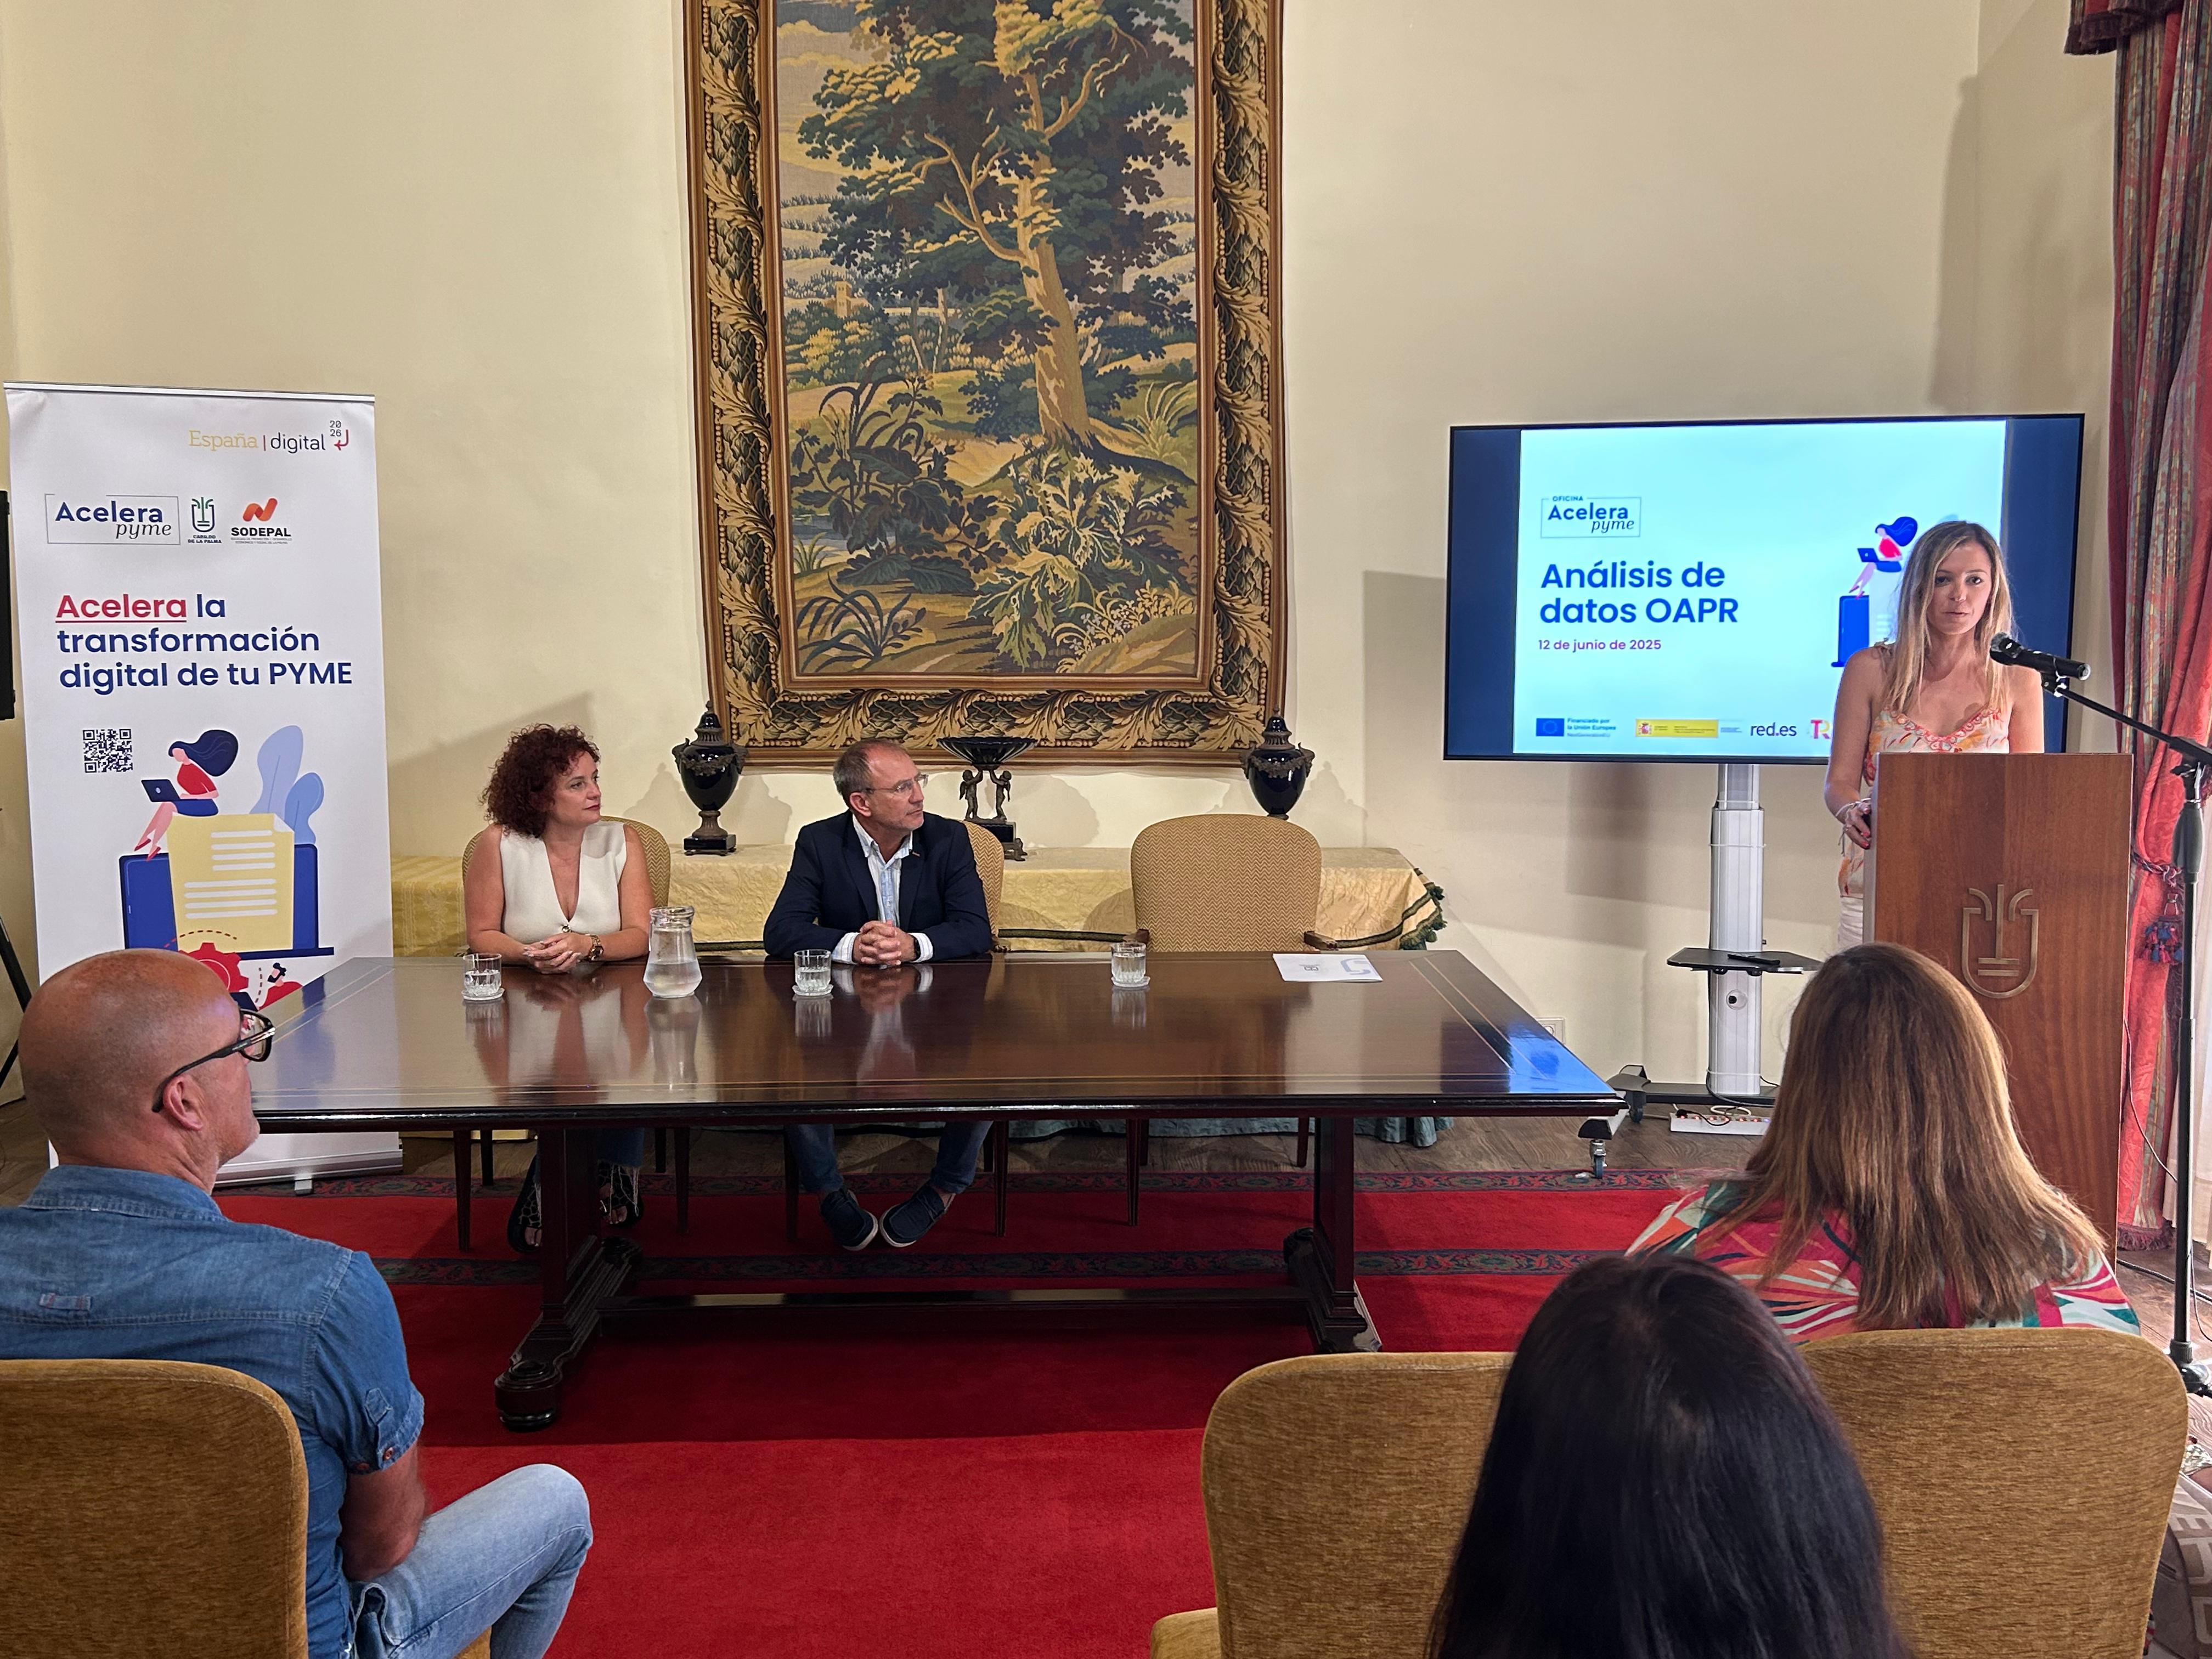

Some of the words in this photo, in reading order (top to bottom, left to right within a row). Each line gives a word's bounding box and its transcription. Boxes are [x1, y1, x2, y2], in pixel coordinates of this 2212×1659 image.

[189, 430, 258, 452] España
[270, 432, 326, 454] digital
[55, 500, 163, 522] Acelera
[1547, 502, 1629, 521] Acelera
[116, 523, 172, 540] pyme
[230, 527, 291, 537] SODEPAL
[1591, 520, 1635, 533] pyme
[1541, 560, 1673, 589] Análisis
[1681, 561, 1725, 588] de
[56, 594, 187, 618] Acelera
[196, 594, 226, 618] la
[1539, 597, 1637, 623] datos
[1645, 597, 1739, 623] OAPR
[57, 626, 320, 653] transformación
[1538, 640, 1550, 650] 12
[1553, 640, 1570, 650] de
[1572, 639, 1606, 653] junio
[1609, 640, 1626, 650] de
[1629, 640, 1662, 650] 2025
[59, 662, 168, 695] digital
[177, 662, 219, 686] de
[227, 663, 259, 685] tu
[269, 662, 352, 685] PYME
[1750, 722, 1797, 736] red.es
